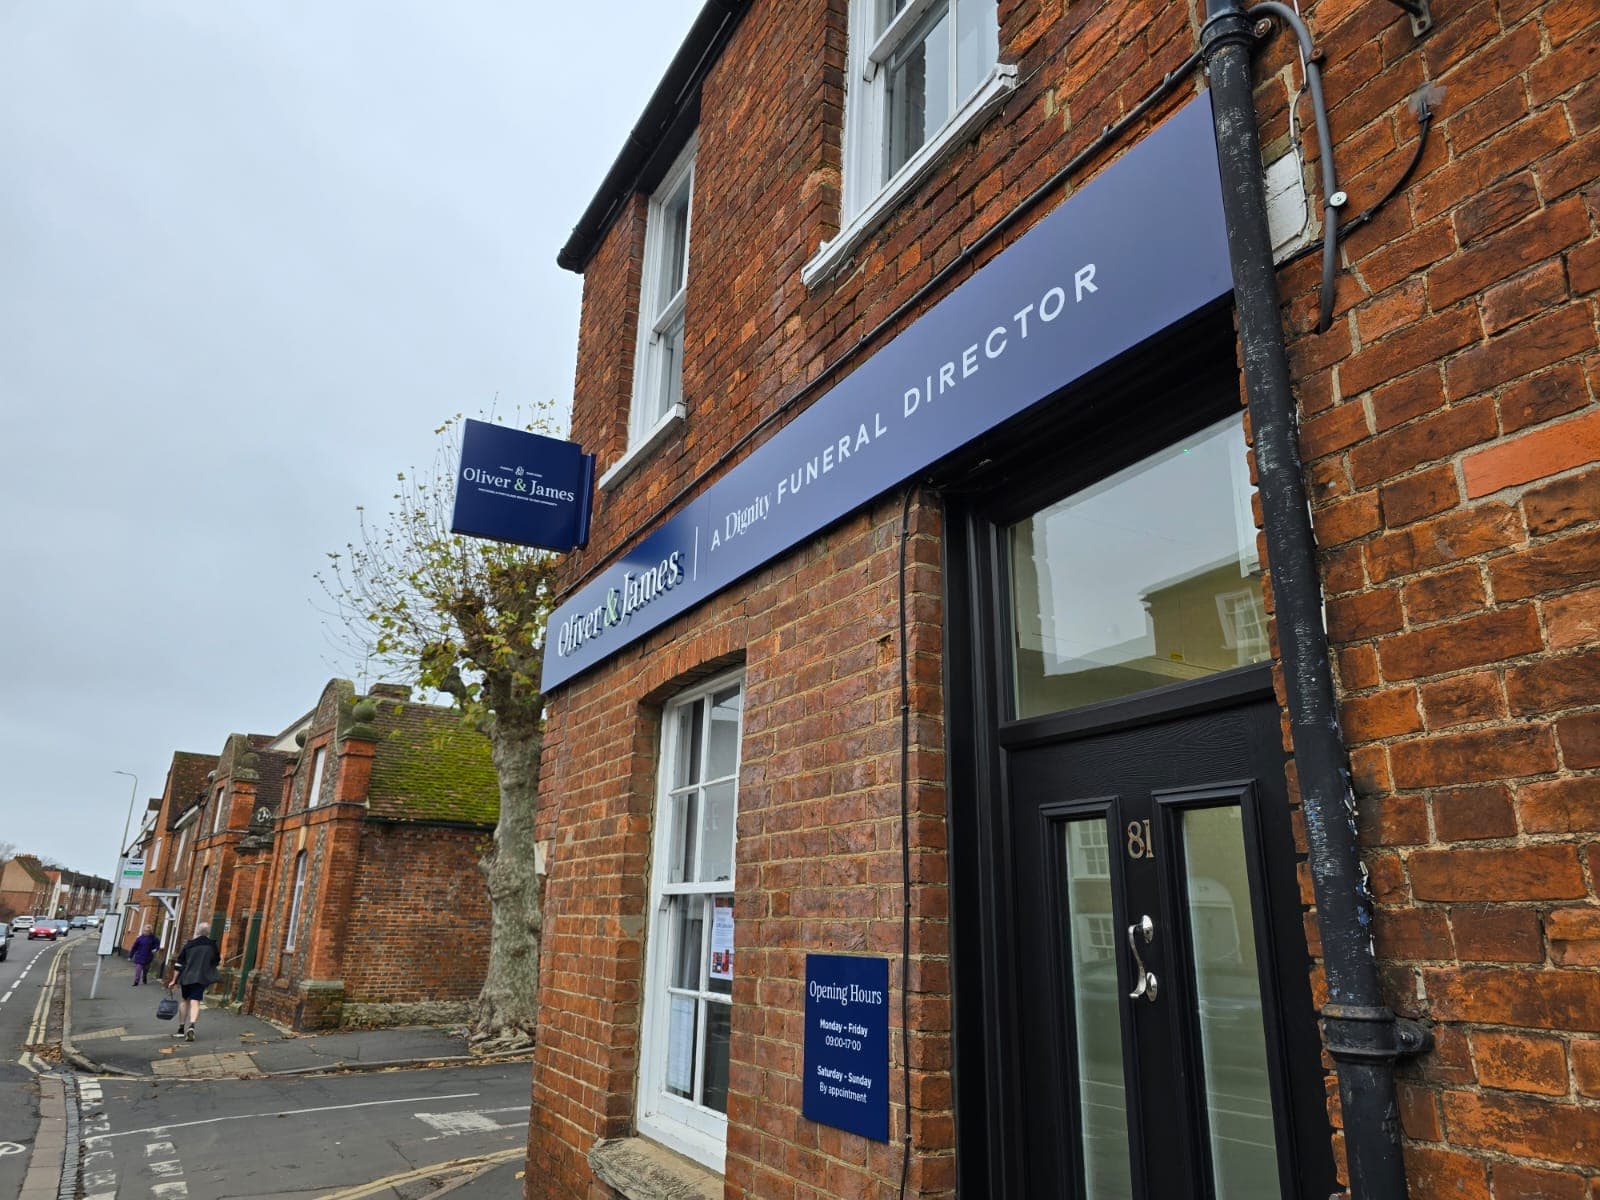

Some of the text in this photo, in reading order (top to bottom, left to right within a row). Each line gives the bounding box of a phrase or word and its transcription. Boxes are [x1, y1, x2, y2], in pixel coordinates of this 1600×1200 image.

[557, 263, 1099, 657] Oliver & James A Dignity FUNERAL DIRECTOR
[463, 467, 511, 489] Oliver
[514, 478, 527, 493] &
[529, 480, 575, 502] James
[1127, 819, 1155, 859] 81
[809, 980, 882, 1006] Opening Hours
[819, 1018, 843, 1034] Monday
[848, 1022, 869, 1038] Friday
[817, 1065, 843, 1082] Saturday
[848, 1072, 872, 1089] Sunday
[819, 1081, 867, 1104] By appointment
